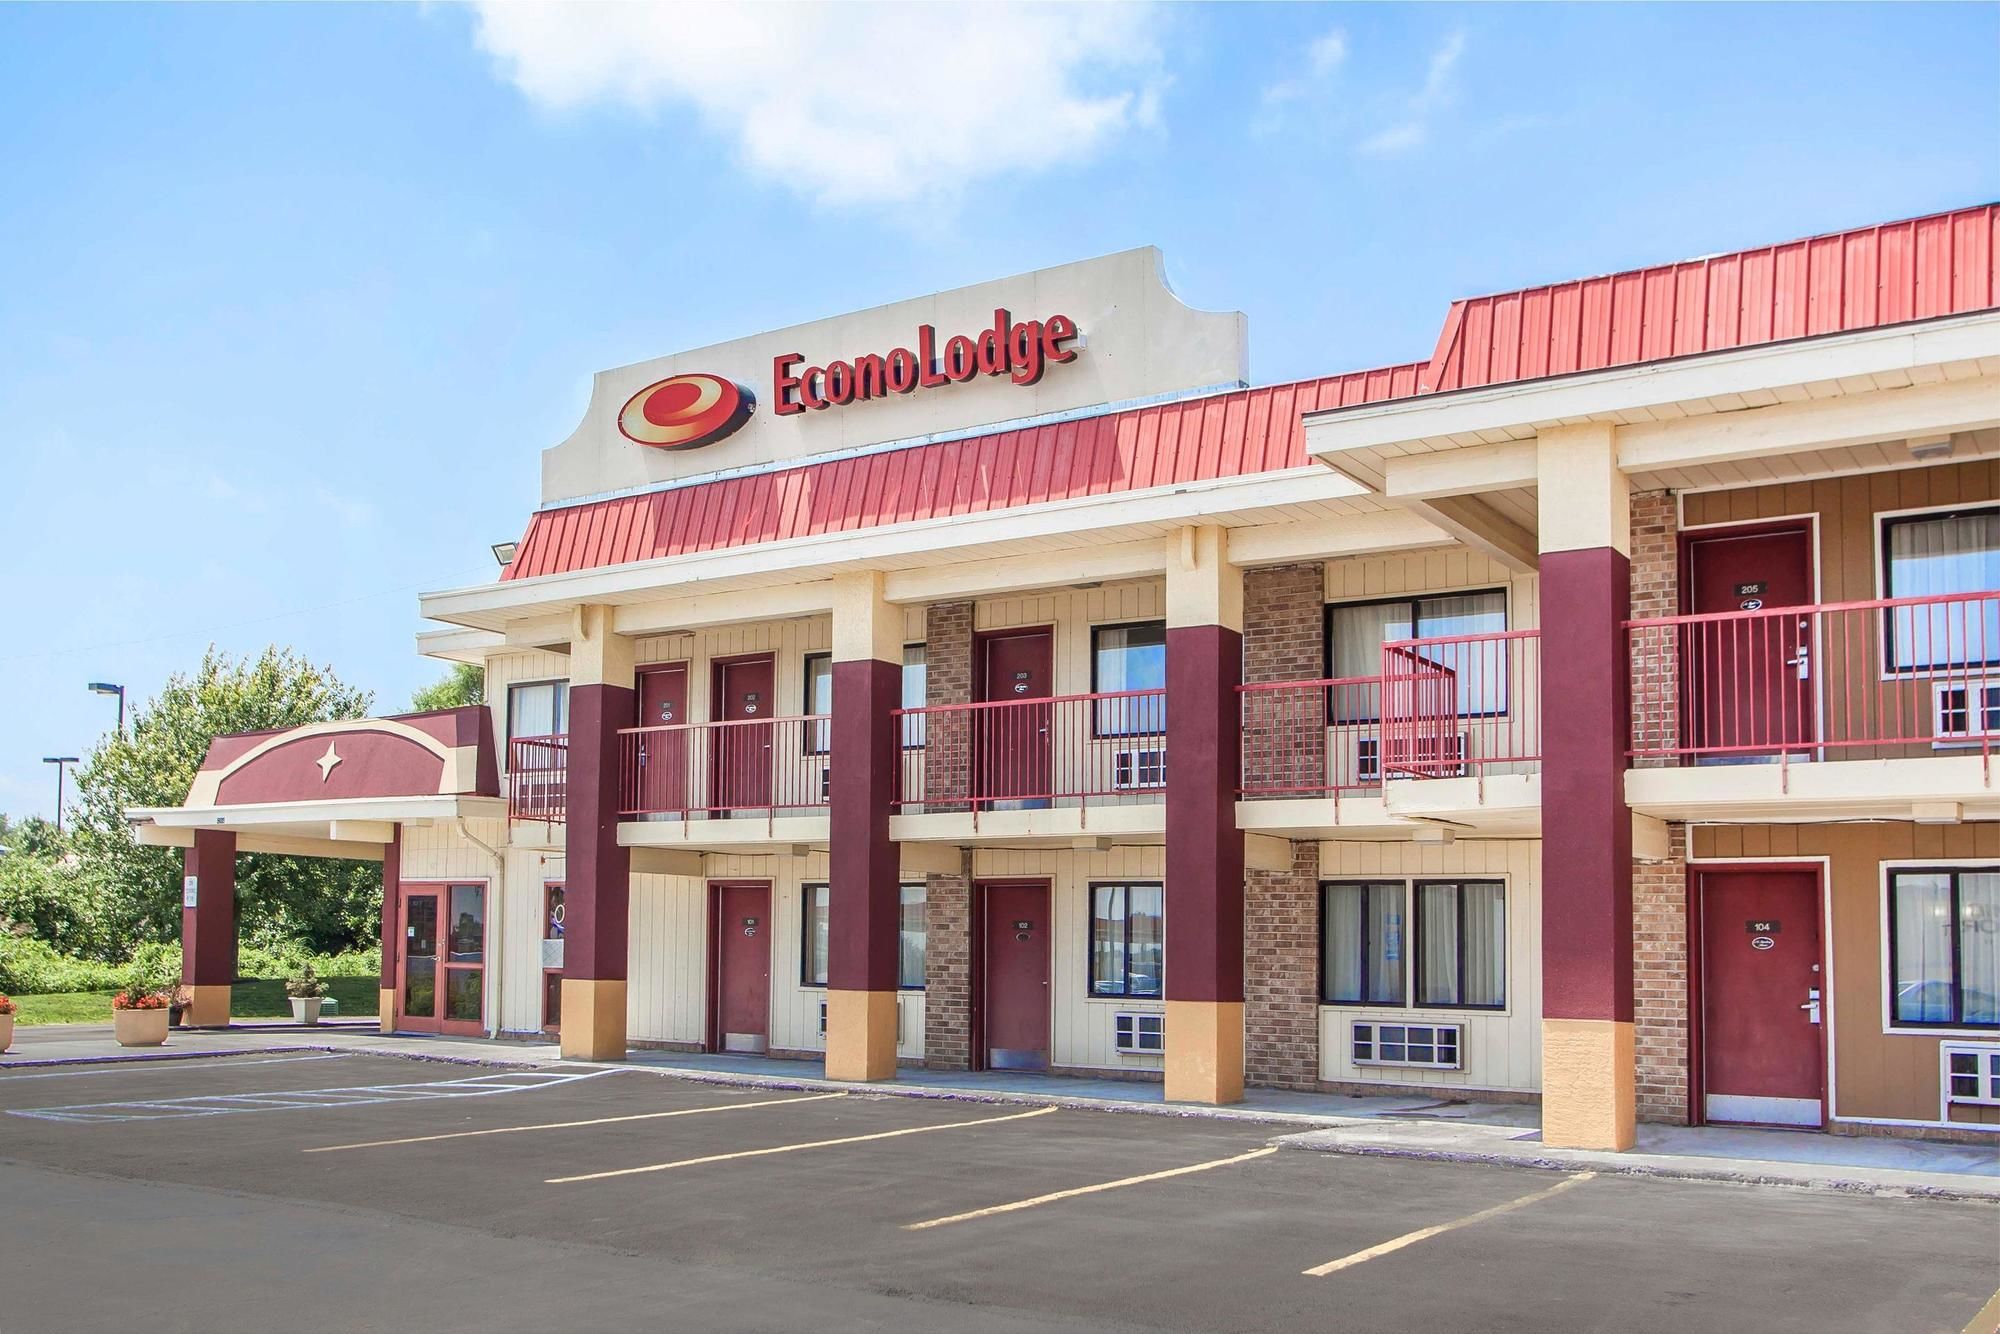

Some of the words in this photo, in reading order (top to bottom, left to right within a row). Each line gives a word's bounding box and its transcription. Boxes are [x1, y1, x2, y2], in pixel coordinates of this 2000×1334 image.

[774, 307, 1077, 415] EconoLodge
[1741, 584, 1759, 594] 205
[1016, 672, 1028, 680] 203
[1754, 923, 1770, 931] 104
